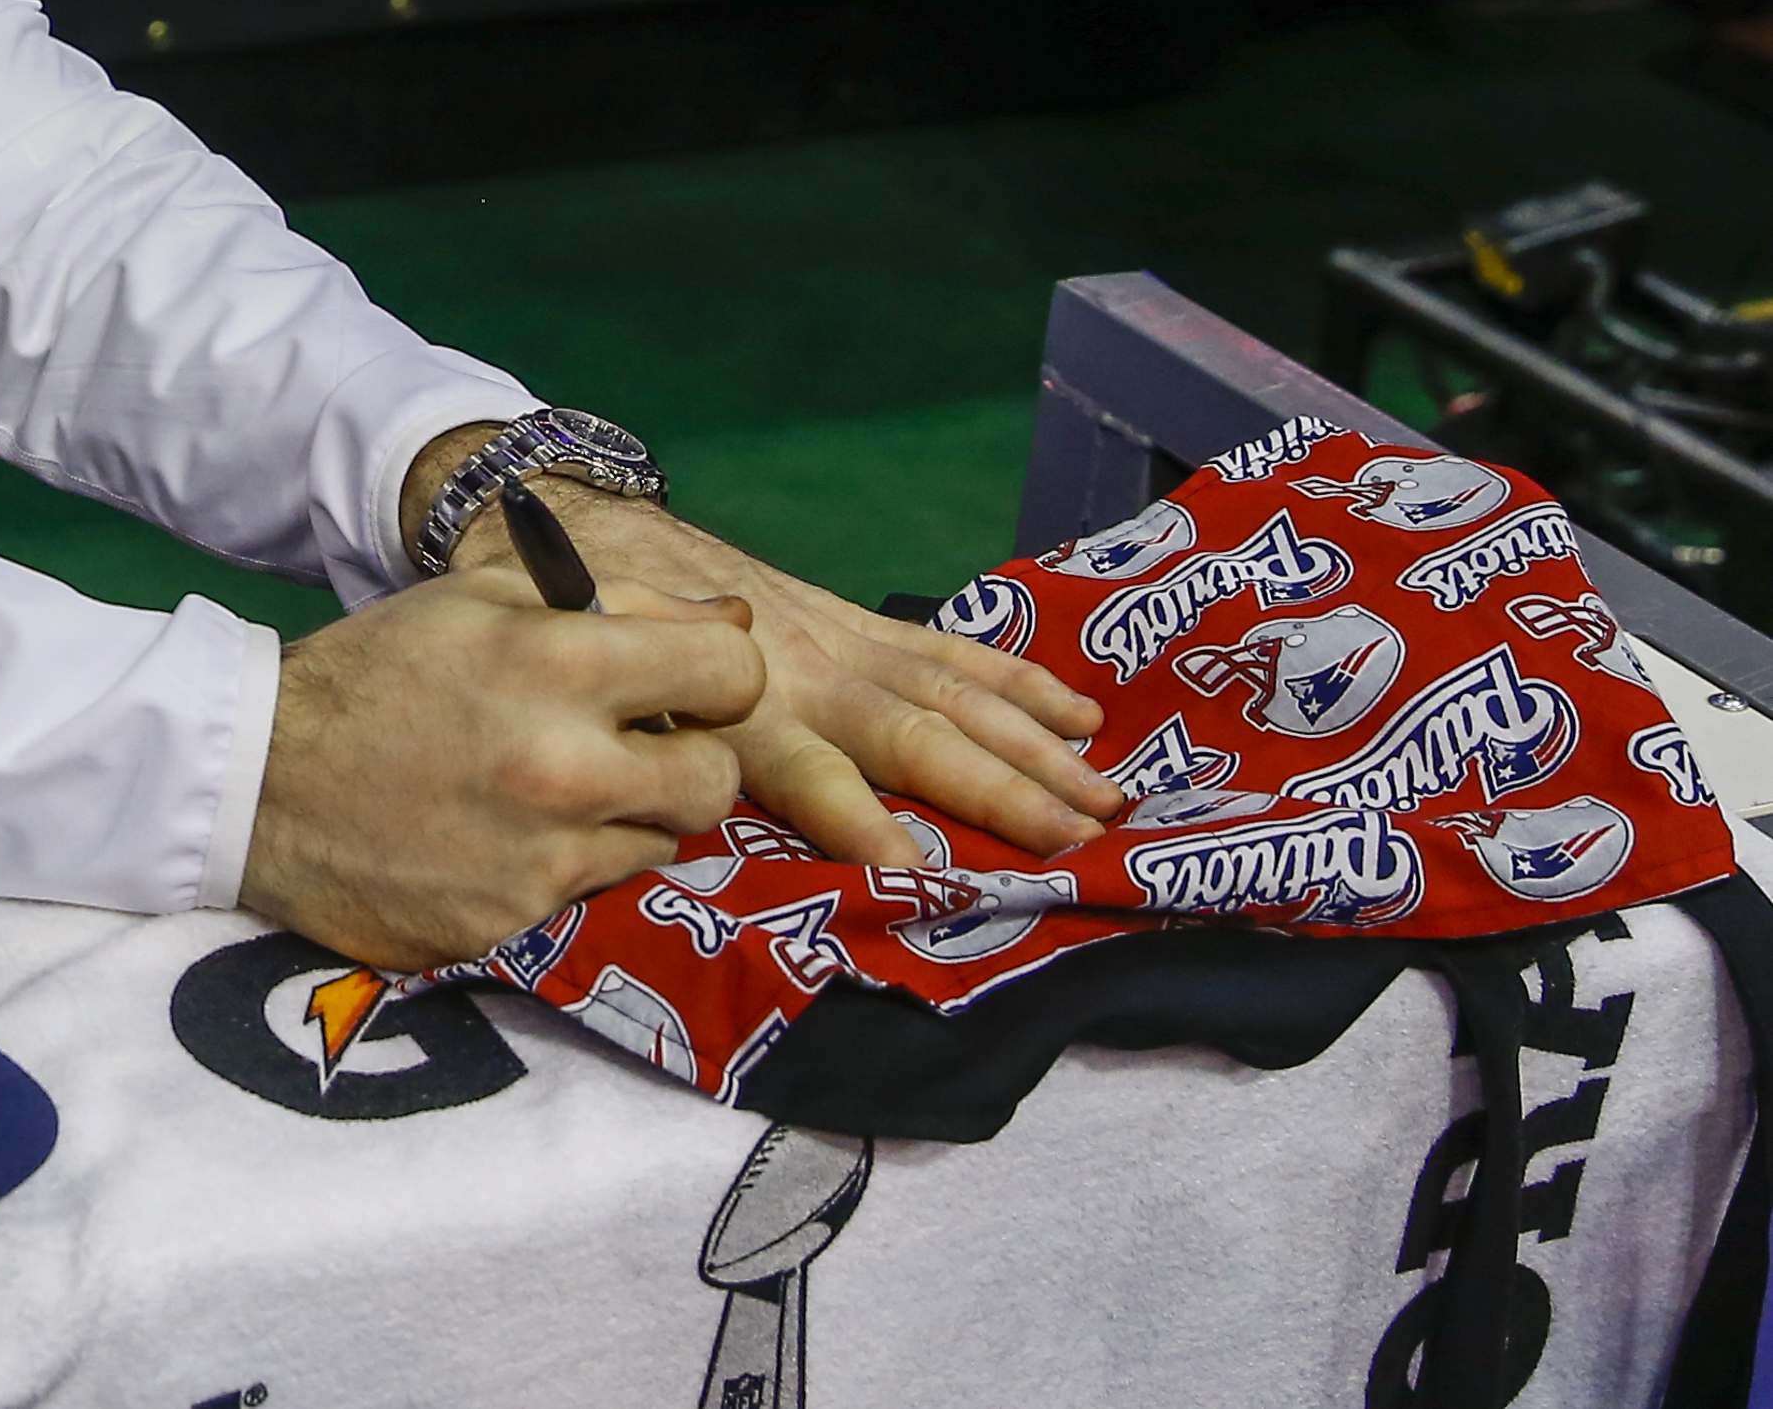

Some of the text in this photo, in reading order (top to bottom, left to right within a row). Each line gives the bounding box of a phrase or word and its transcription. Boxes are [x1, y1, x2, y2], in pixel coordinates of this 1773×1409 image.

[1084, 511, 1348, 683] Patriots
[1127, 813, 1422, 925] Patriots
[170, 929, 528, 1120] G
